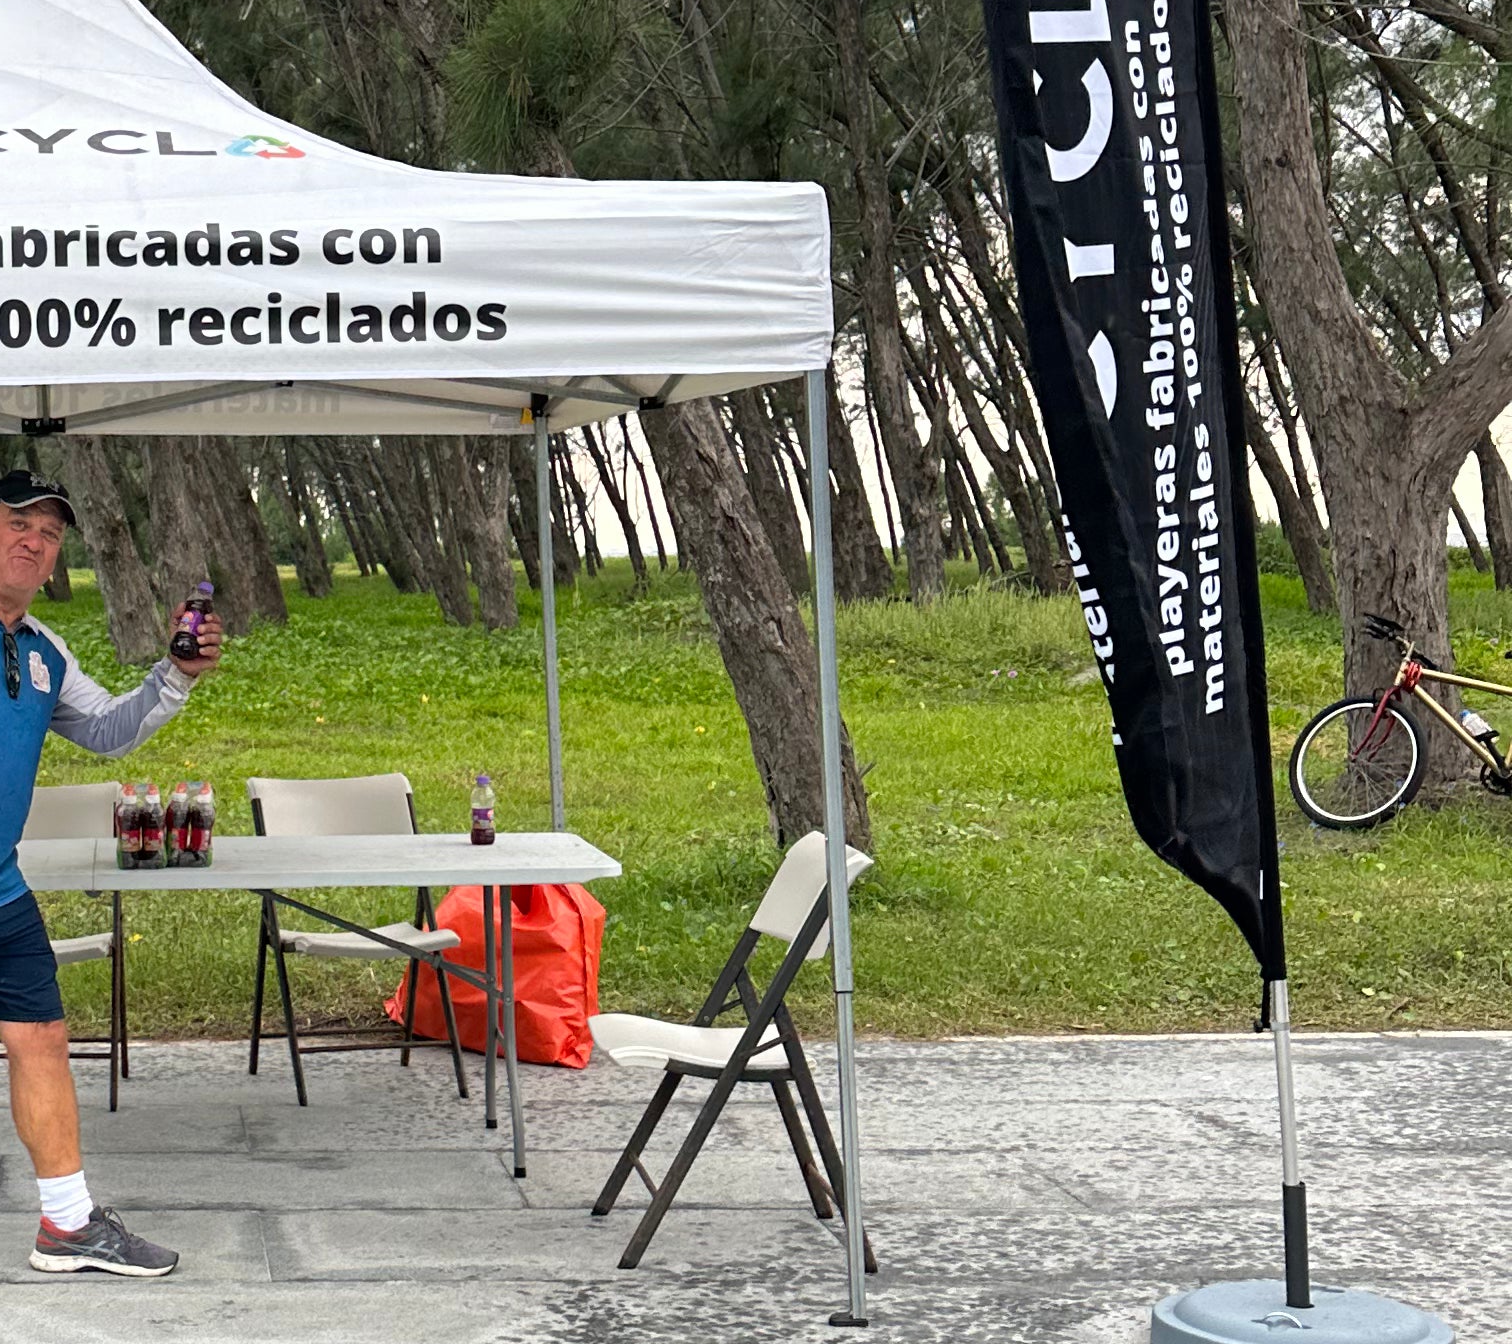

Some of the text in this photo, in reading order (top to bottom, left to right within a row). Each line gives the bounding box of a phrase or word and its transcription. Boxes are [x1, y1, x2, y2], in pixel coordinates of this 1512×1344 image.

[158, 291, 507, 346] reciclados
[322, 227, 442, 266] con
[1124, 20, 1195, 677] playeras fabricadas con
[1175, 263, 1202, 409] 100%
[1189, 423, 1225, 715] materiales
